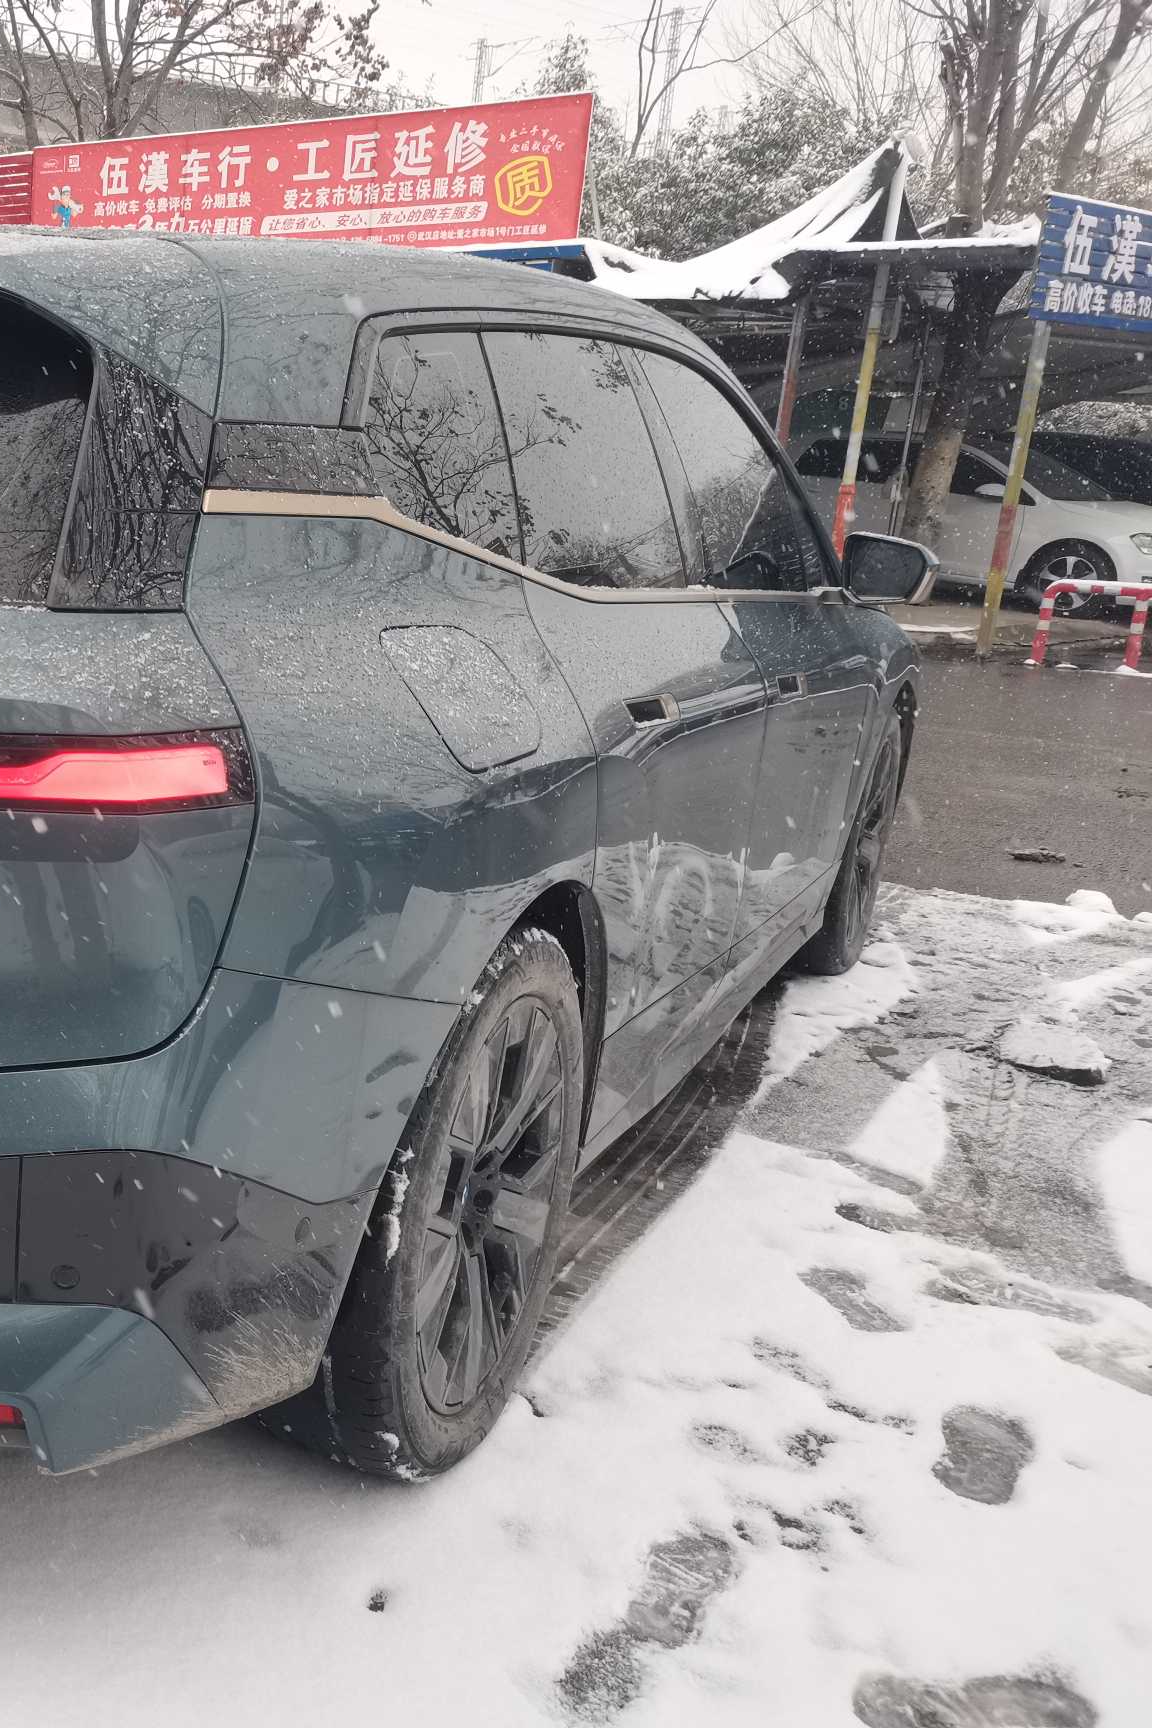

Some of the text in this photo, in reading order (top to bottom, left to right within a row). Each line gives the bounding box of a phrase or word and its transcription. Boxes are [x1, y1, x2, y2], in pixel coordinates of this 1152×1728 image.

[94, 191, 252, 217] 高价收车 免费评估 分期置换
[282, 174, 486, 210] 爱之家市场指定延保服务商
[1062, 204, 1152, 284] 伍漢
[1043, 279, 1152, 319] 高价收车 电话:18
